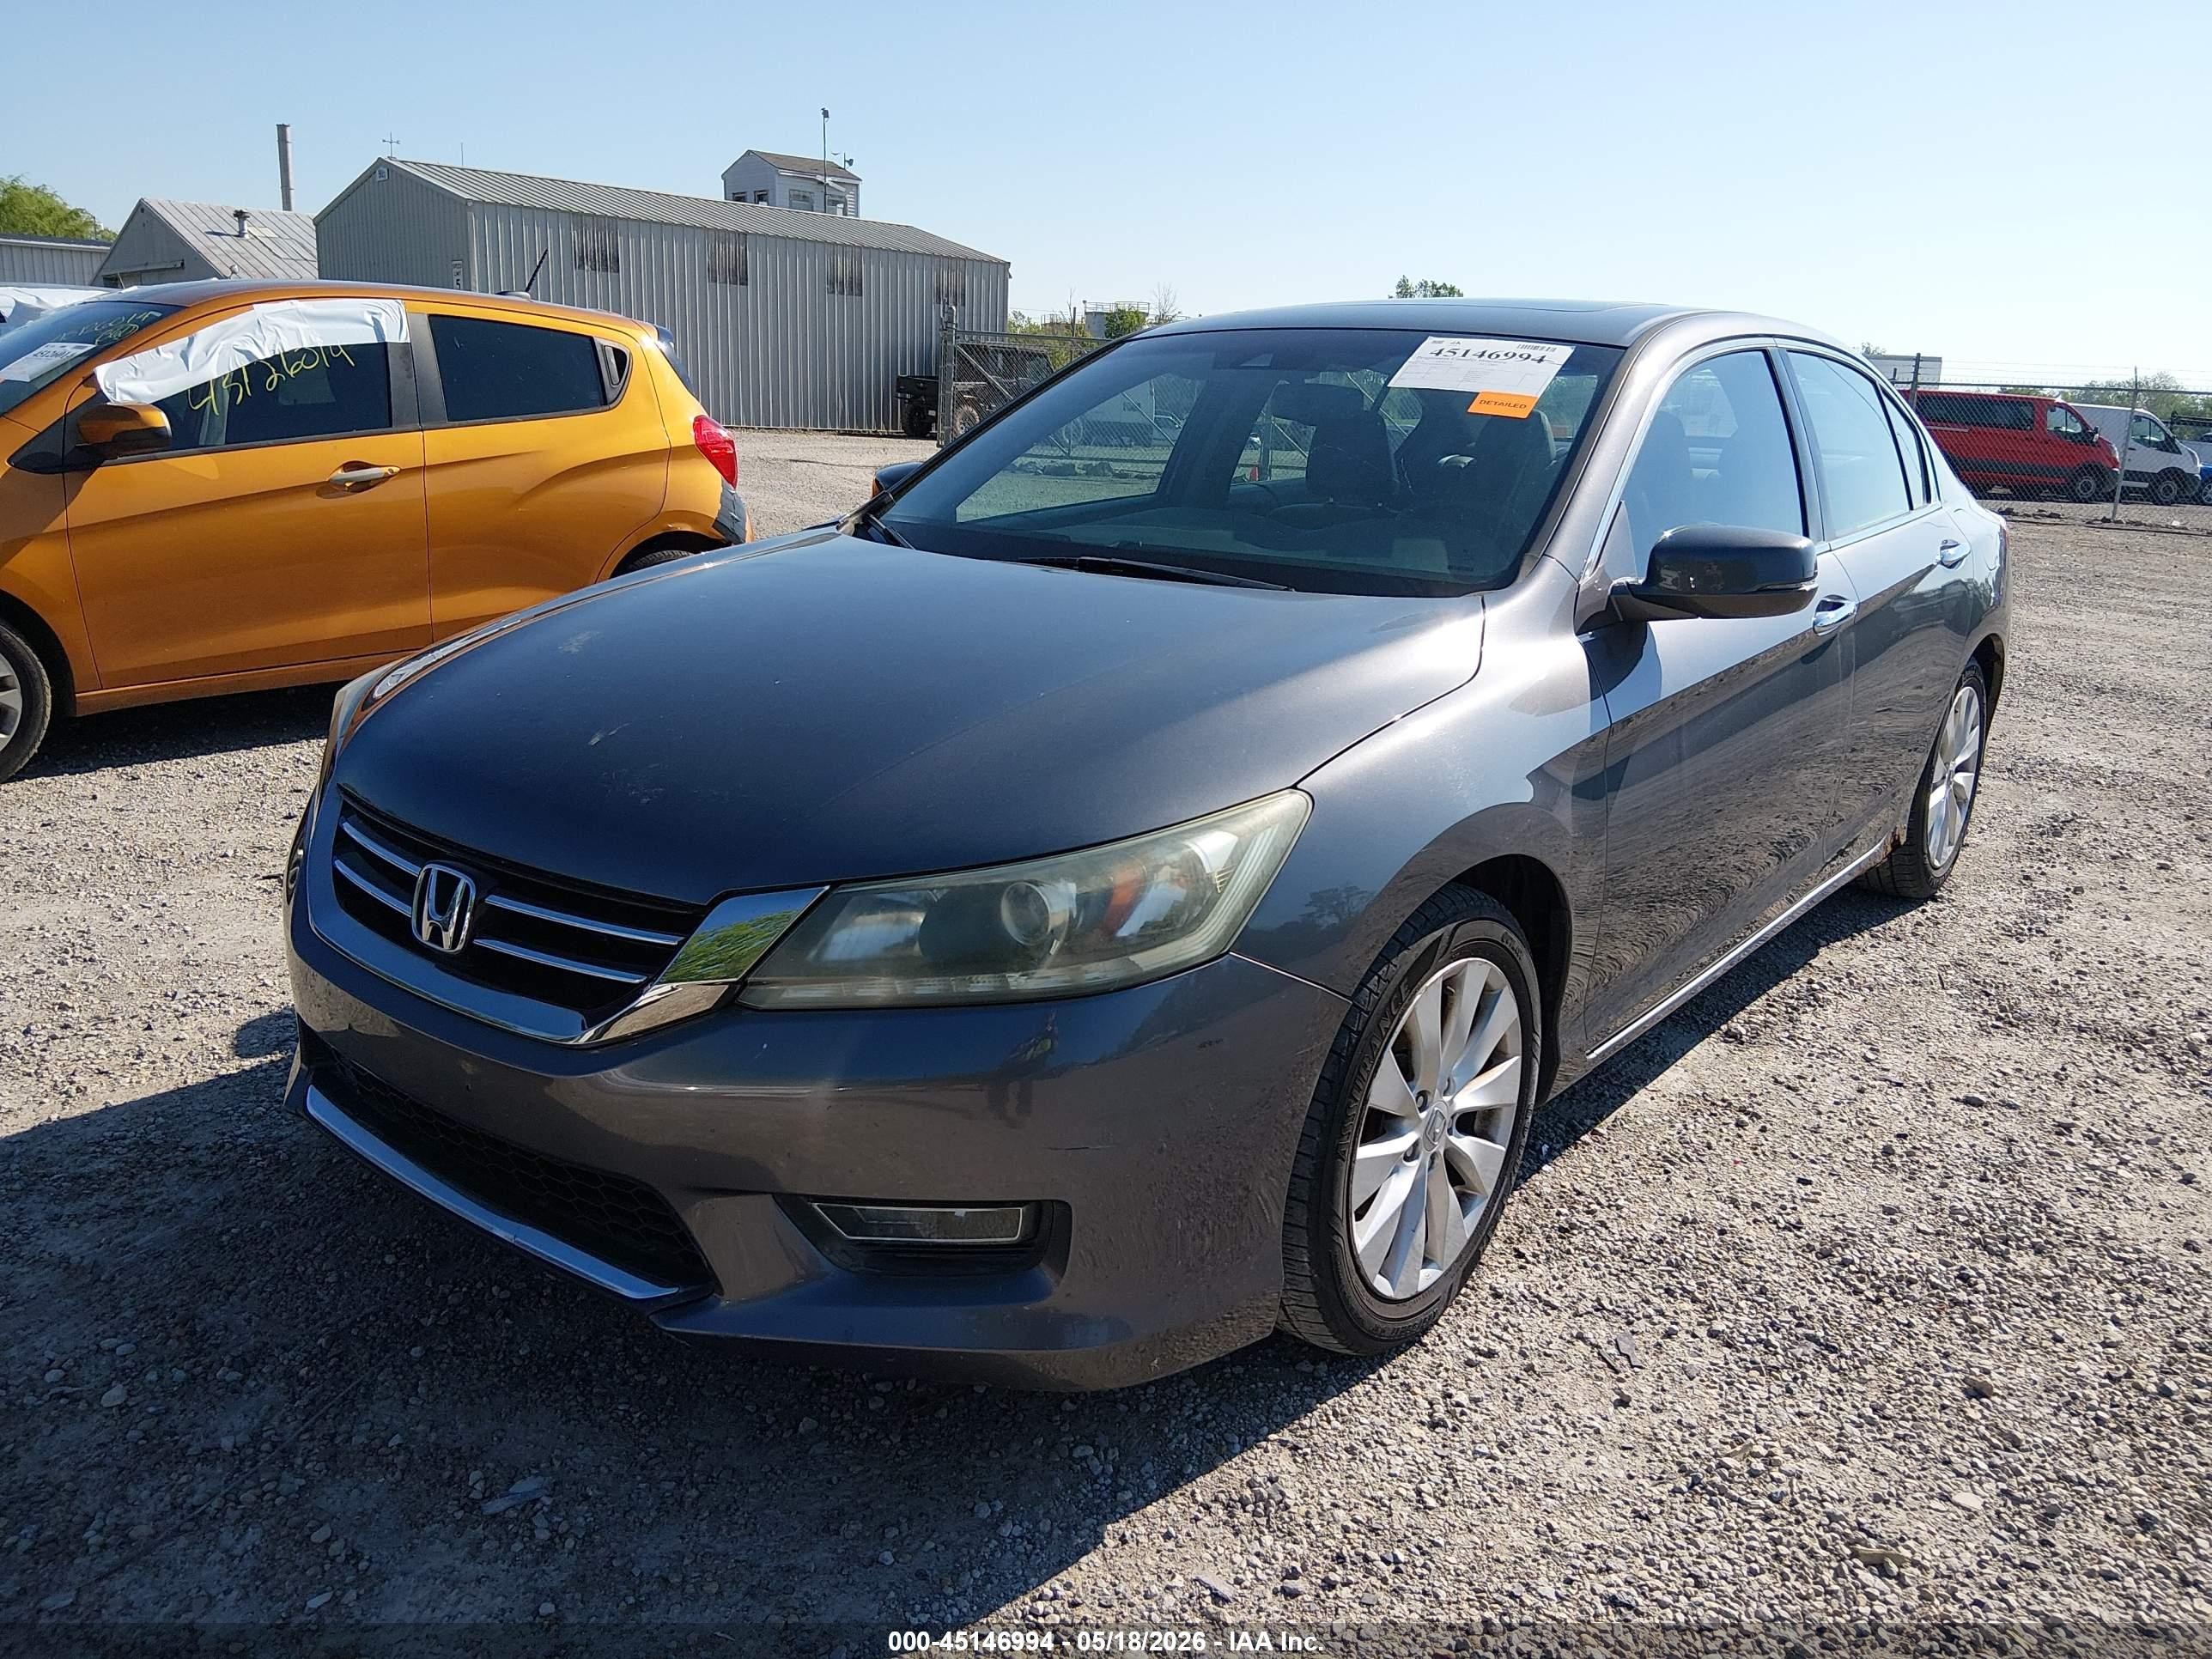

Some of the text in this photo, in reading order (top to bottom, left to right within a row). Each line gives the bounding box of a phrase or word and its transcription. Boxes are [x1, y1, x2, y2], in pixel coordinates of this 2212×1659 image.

[1429, 347, 1547, 365] 45146994
[1479, 398, 1528, 410] DETAILED
[1337, 977, 1411, 1163] ASSURANCE
